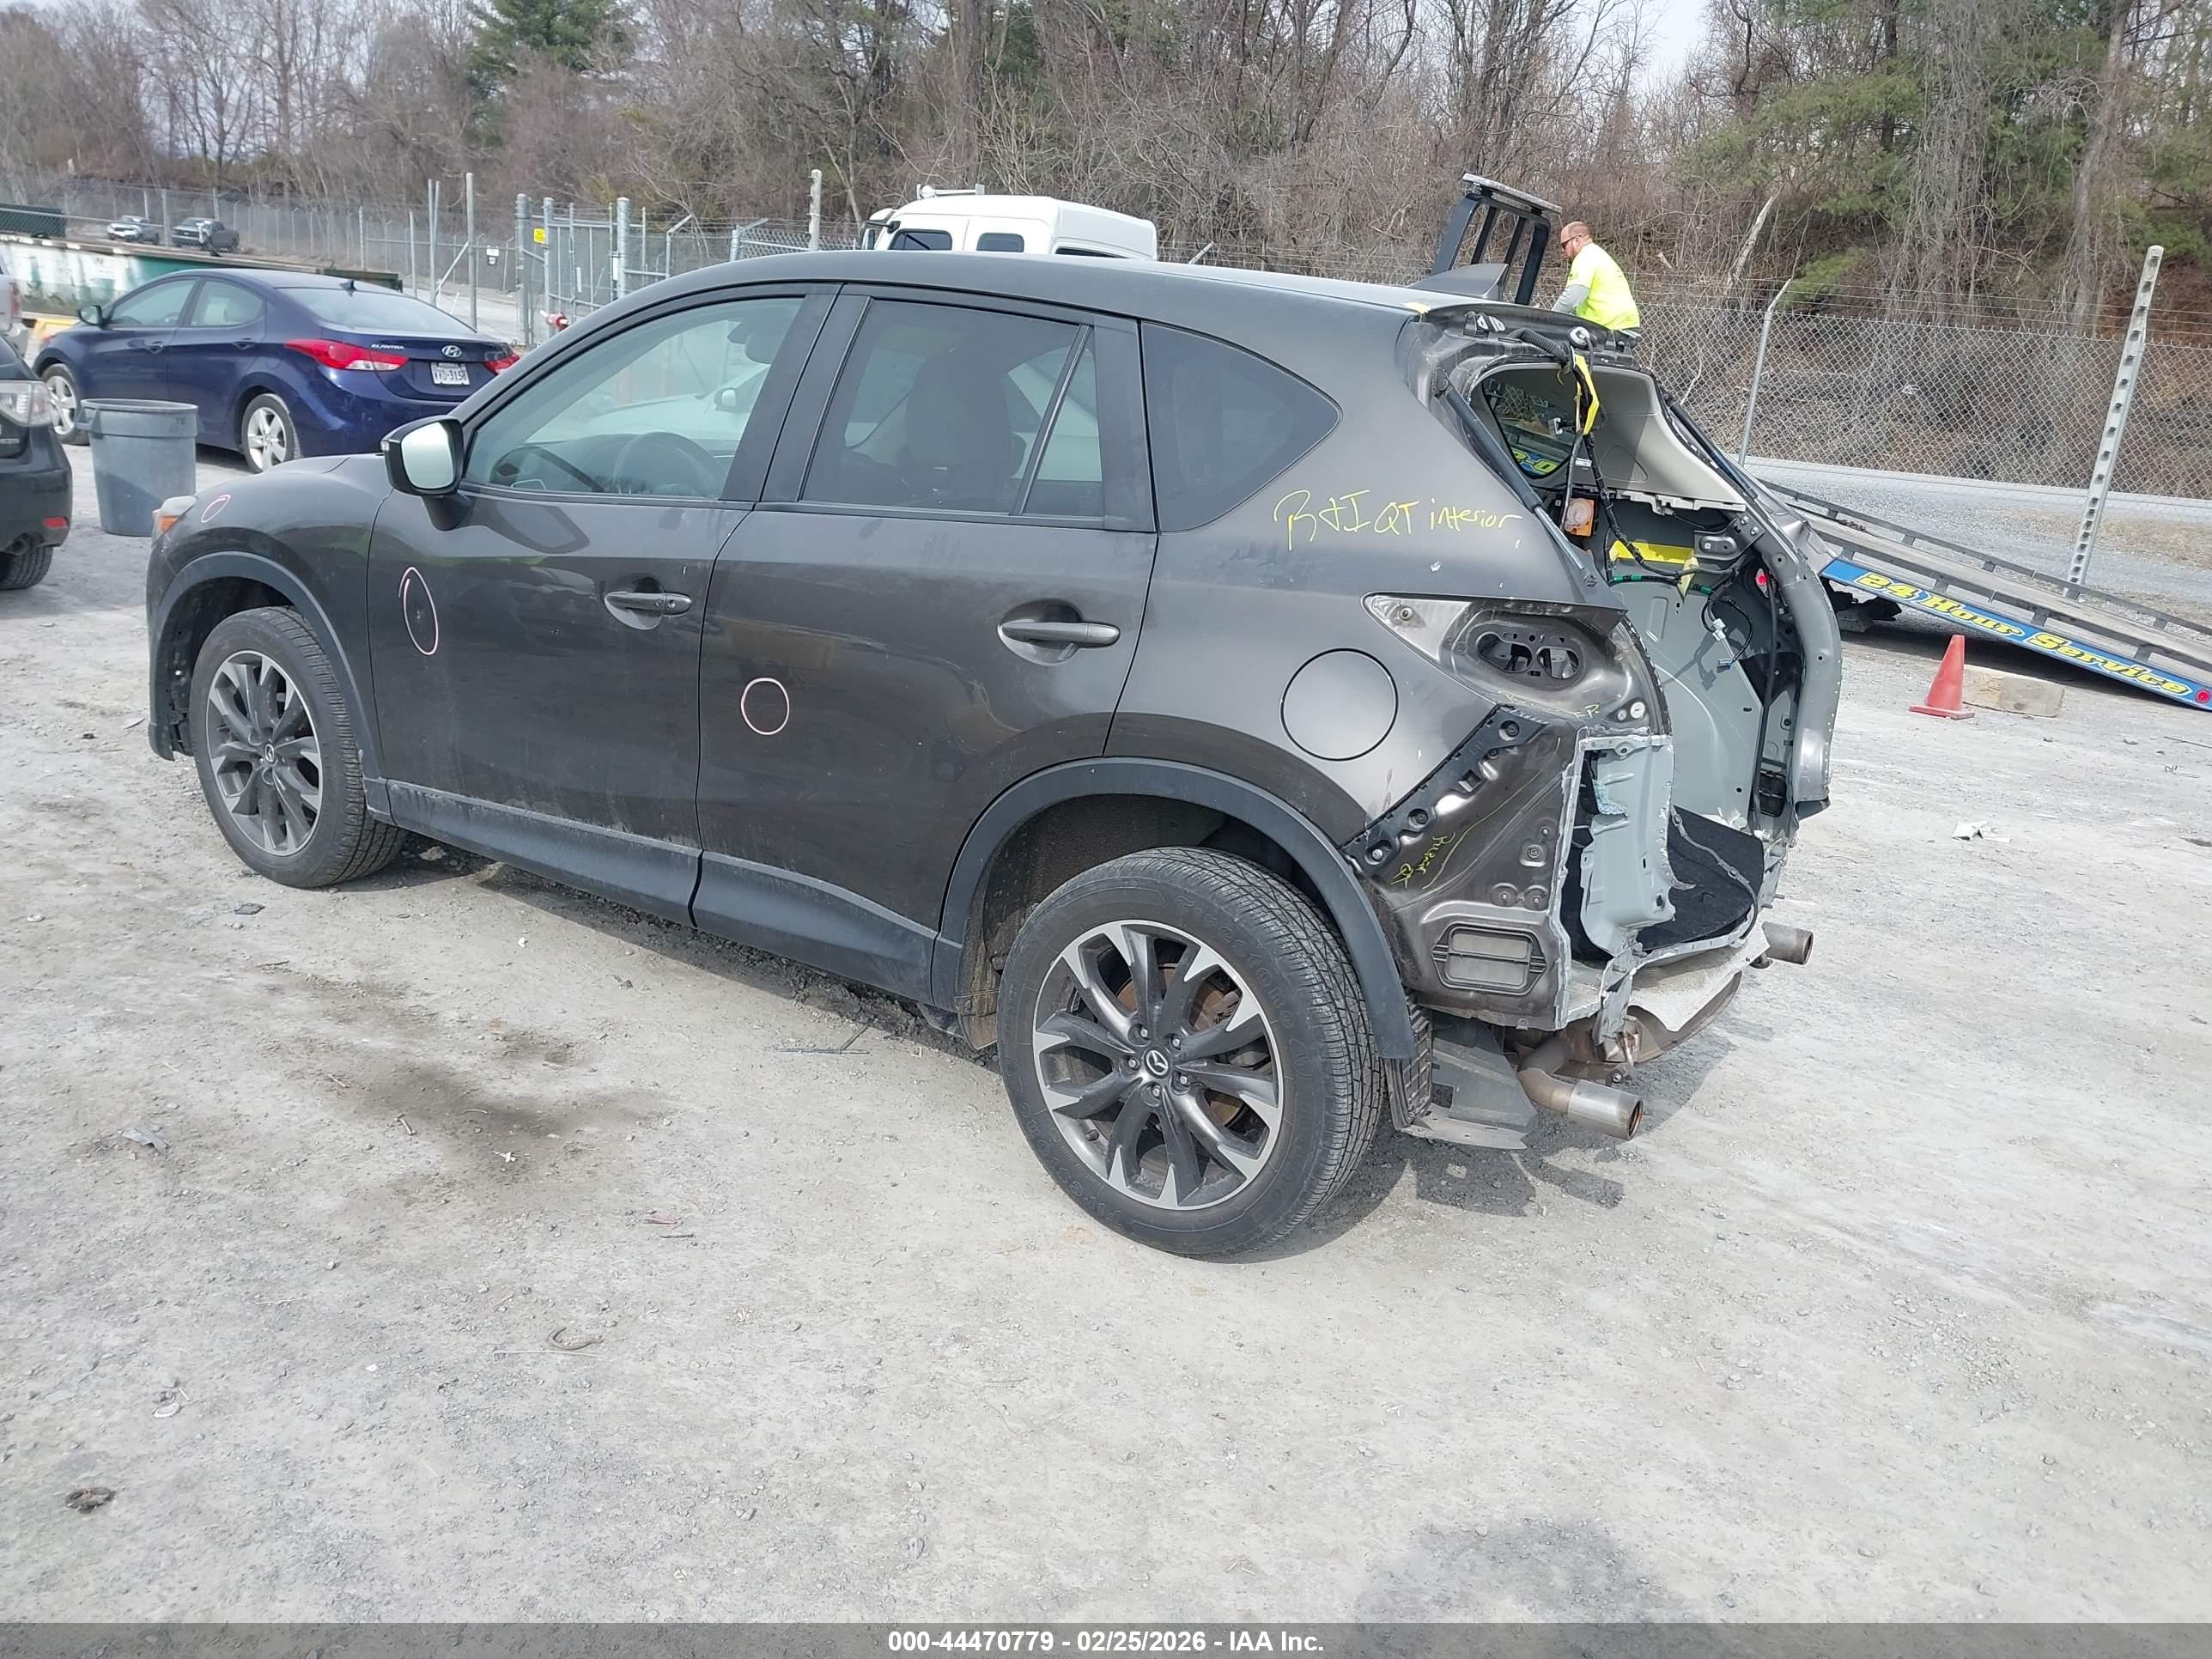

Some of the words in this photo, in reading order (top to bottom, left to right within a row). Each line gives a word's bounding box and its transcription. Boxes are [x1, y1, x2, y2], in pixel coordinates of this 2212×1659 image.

[1429, 497, 1524, 532] interior
[1854, 572, 1919, 601] 24
[1920, 592, 2025, 638] Hour
[2024, 632, 2192, 696] Service
